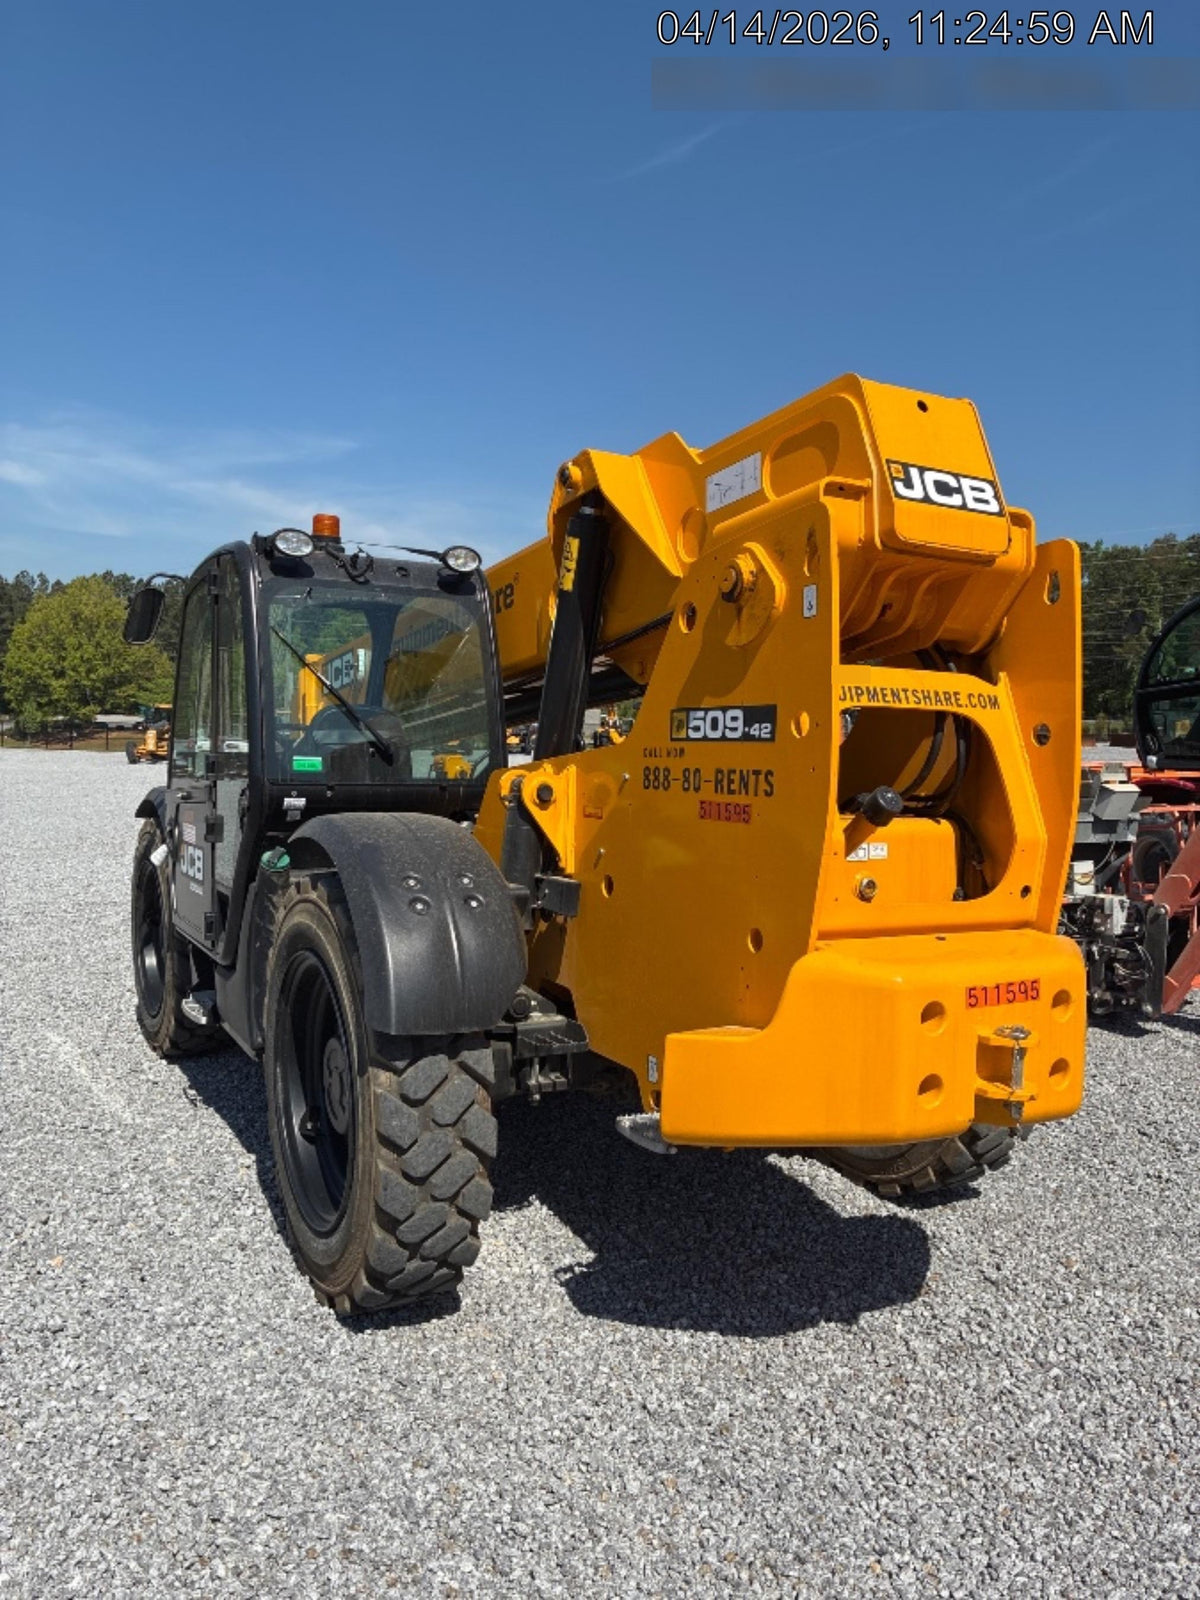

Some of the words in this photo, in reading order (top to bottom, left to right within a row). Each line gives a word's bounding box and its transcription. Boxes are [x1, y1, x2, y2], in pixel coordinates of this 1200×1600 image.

[893, 466, 1001, 513] JCB
[643, 766, 774, 797] 888-80-RENTS
[699, 801, 751, 824] 511595
[180, 844, 204, 880] JCB
[967, 980, 1039, 1008] 511595
